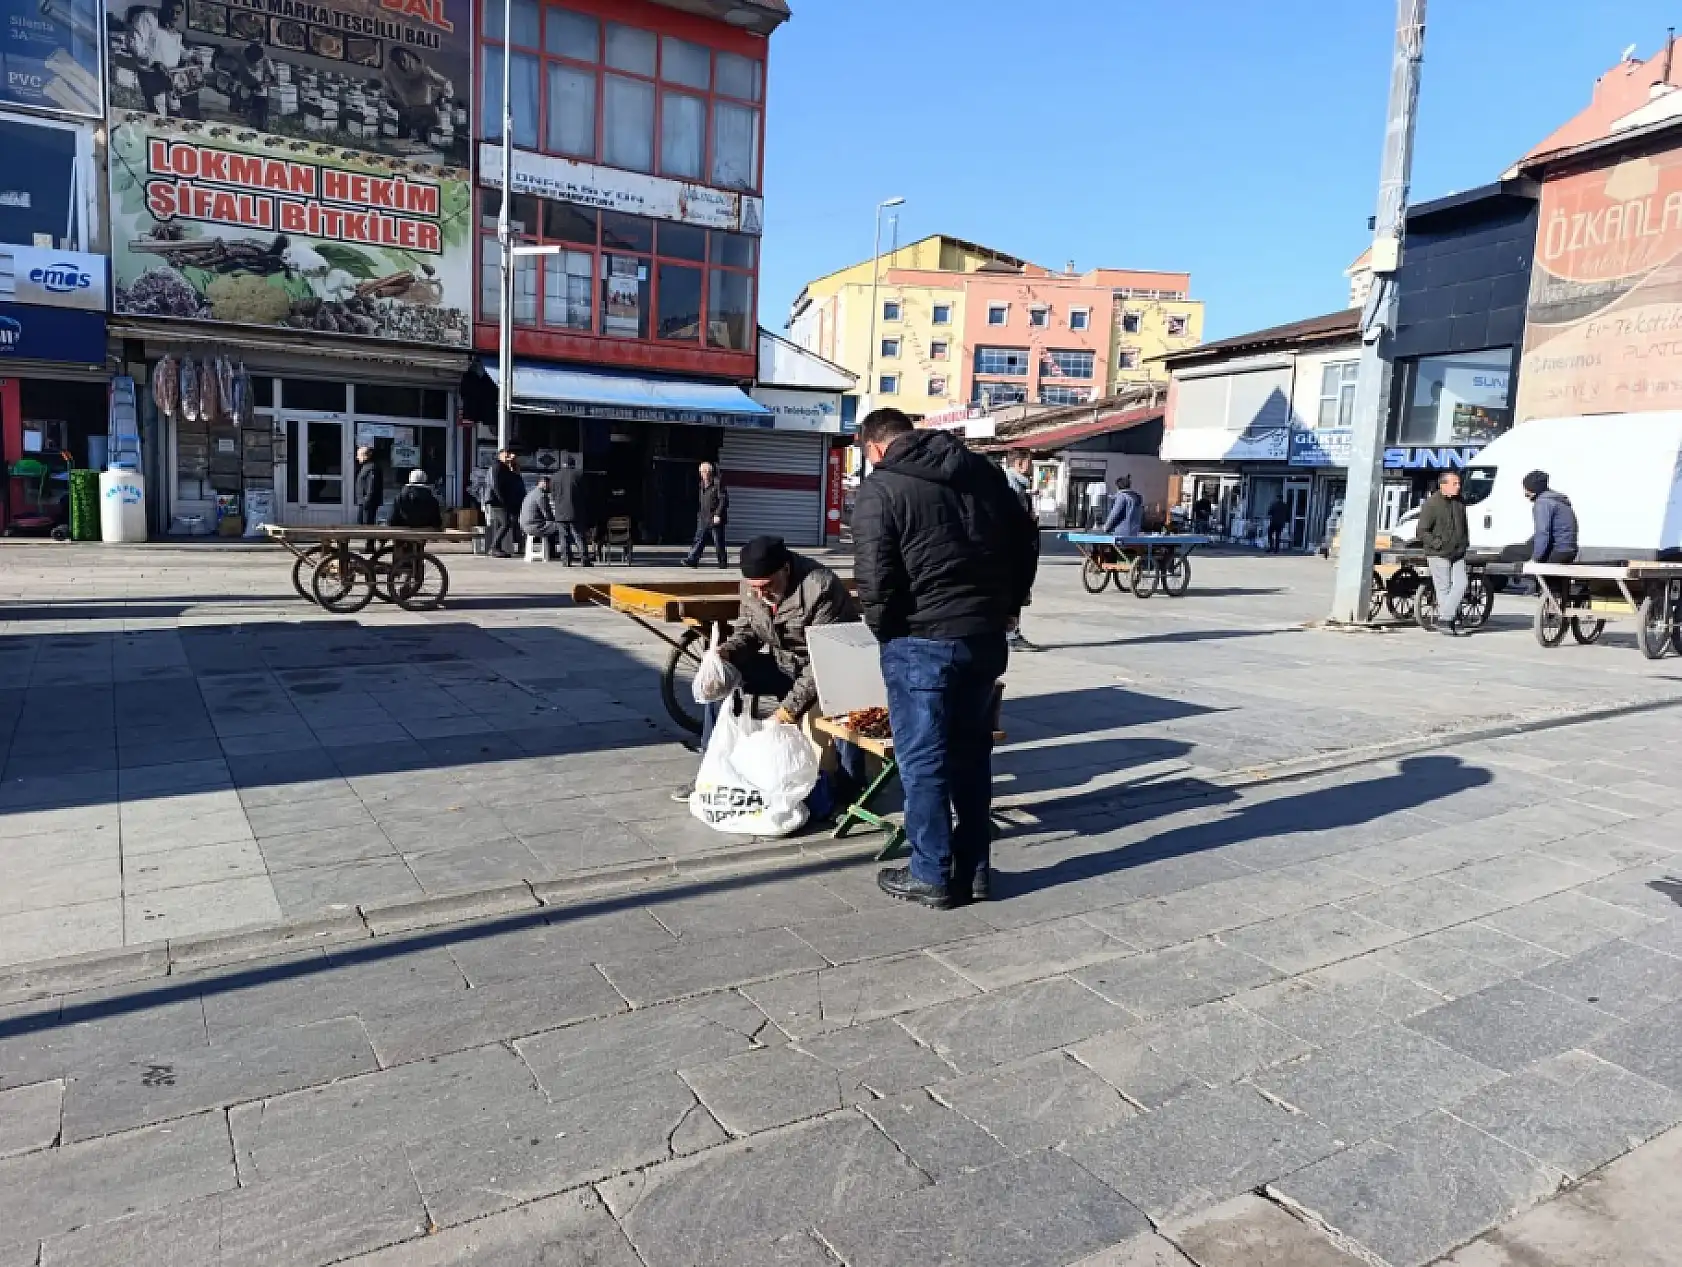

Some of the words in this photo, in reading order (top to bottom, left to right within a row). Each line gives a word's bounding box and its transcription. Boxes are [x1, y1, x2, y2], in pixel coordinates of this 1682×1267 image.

[8, 71, 42, 88] PVC
[149, 139, 317, 197] LOKMAN
[323, 168, 439, 217] HEKİM
[147, 178, 274, 228] ŞİFALI
[279, 199, 441, 251] BİTKİLER
[29, 264, 92, 291] emas
